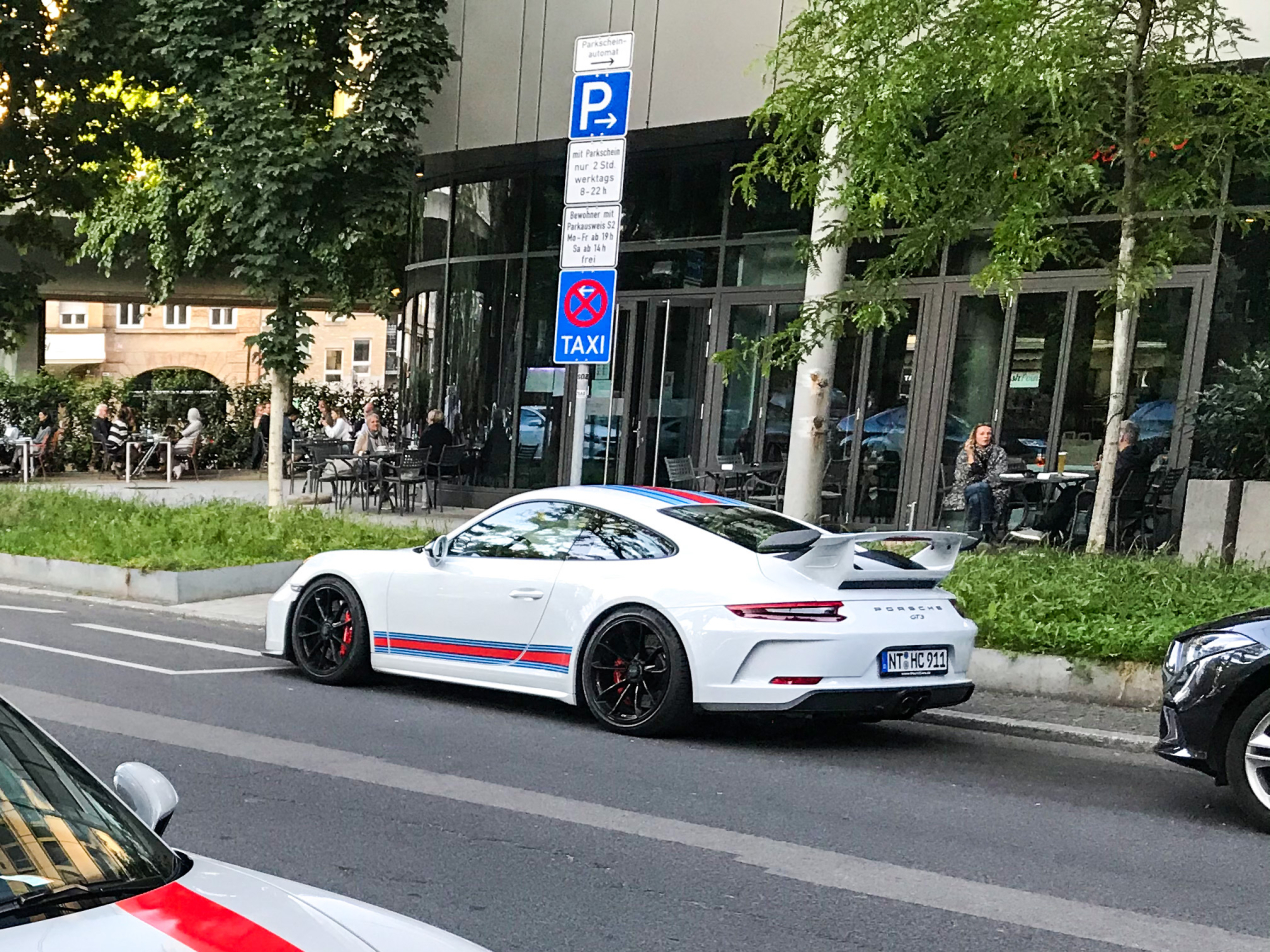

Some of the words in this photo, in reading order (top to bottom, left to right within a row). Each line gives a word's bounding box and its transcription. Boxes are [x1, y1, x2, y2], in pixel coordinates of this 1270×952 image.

[582, 39, 627, 49] Parkschein-
[588, 49, 619, 58] automat
[580, 81, 612, 130] P
[572, 150, 583, 159] mit
[585, 147, 620, 158] Parkschein
[574, 163, 589, 171] nur
[593, 161, 598, 170] 2
[575, 173, 614, 184] werktags
[570, 210, 601, 220] Bewohner
[603, 210, 614, 218] mit
[567, 222, 606, 231] Parkausweis
[607, 221, 616, 230] S2
[591, 233, 599, 241] ab
[572, 244, 581, 253] Sa
[583, 244, 591, 253] ab
[581, 255, 596, 264] frei
[561, 335, 605, 355] TAXI
[889, 652, 903, 669] NT
